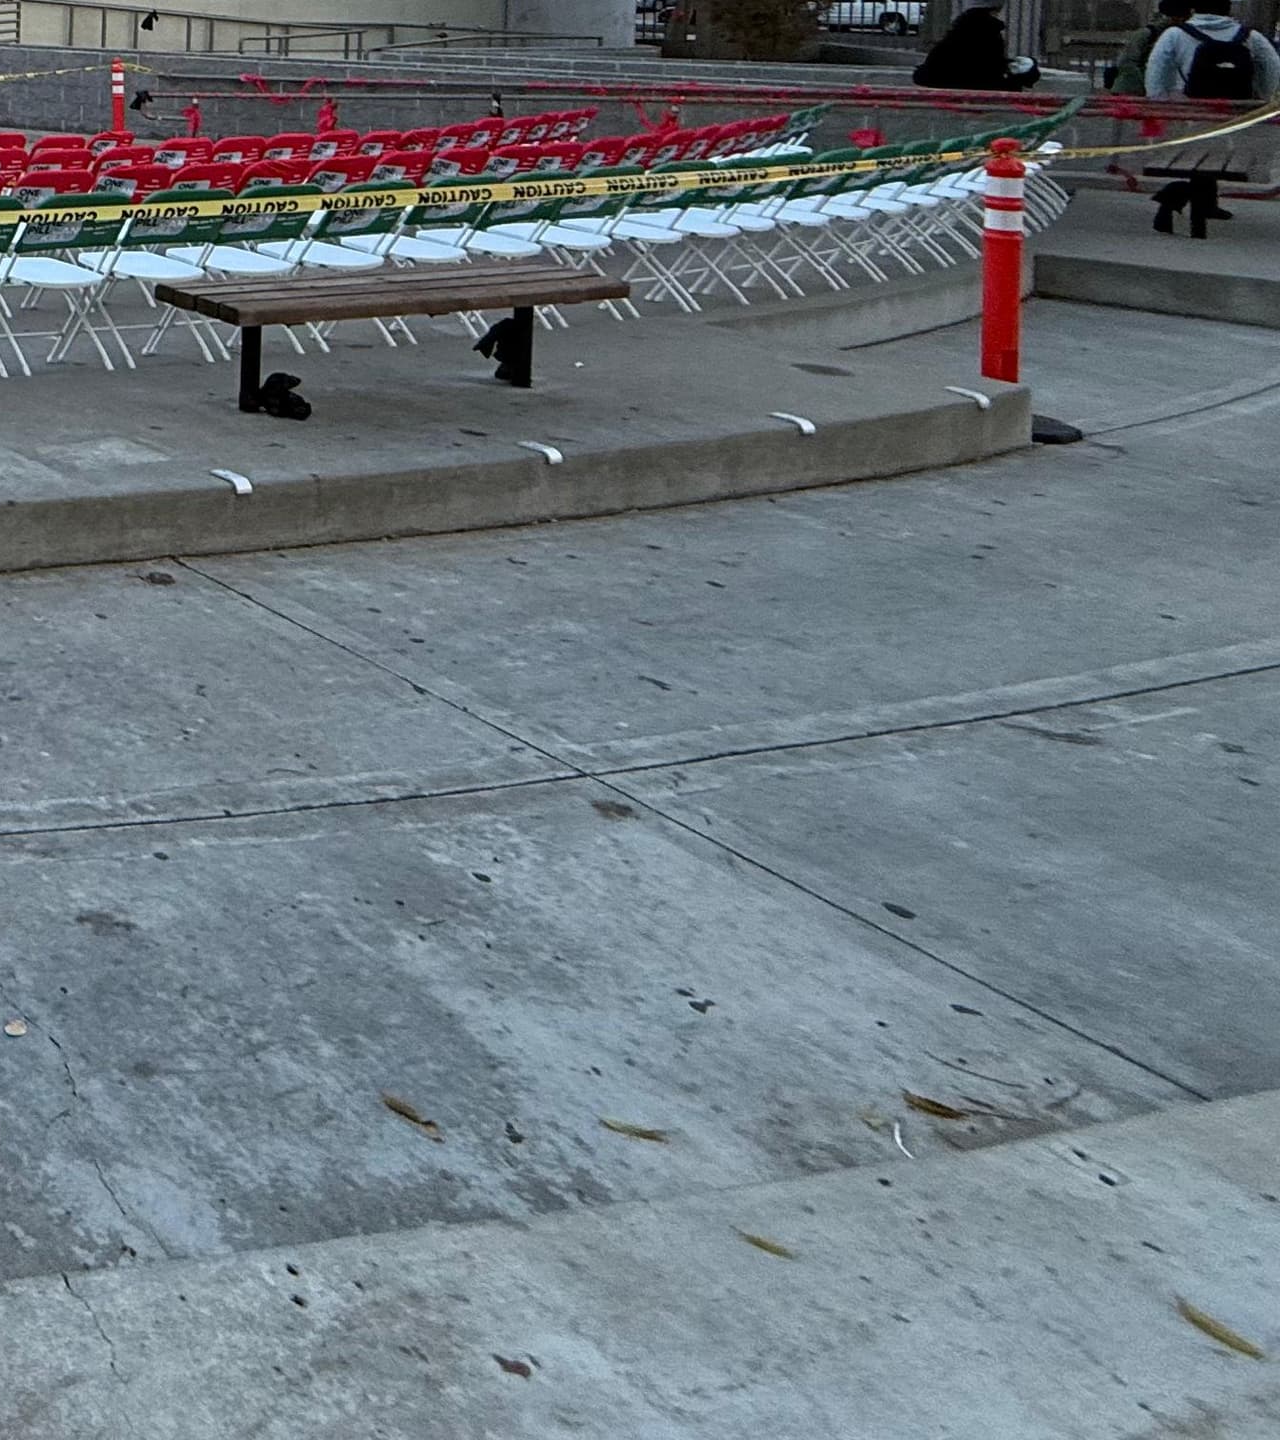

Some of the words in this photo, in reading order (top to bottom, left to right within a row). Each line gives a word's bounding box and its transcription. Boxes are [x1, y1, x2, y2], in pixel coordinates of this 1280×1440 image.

[18, 211, 98, 225] CAUTION
[121, 206, 200, 220] CAUTION
[221, 200, 299, 215] CAUTION
[320, 194, 397, 210] CAUTION
[418, 188, 492, 204] CAUTION
[513, 181, 587, 199] CAUTION
[606, 174, 680, 192] CAUTION
[697, 168, 769, 185] CAUTION
